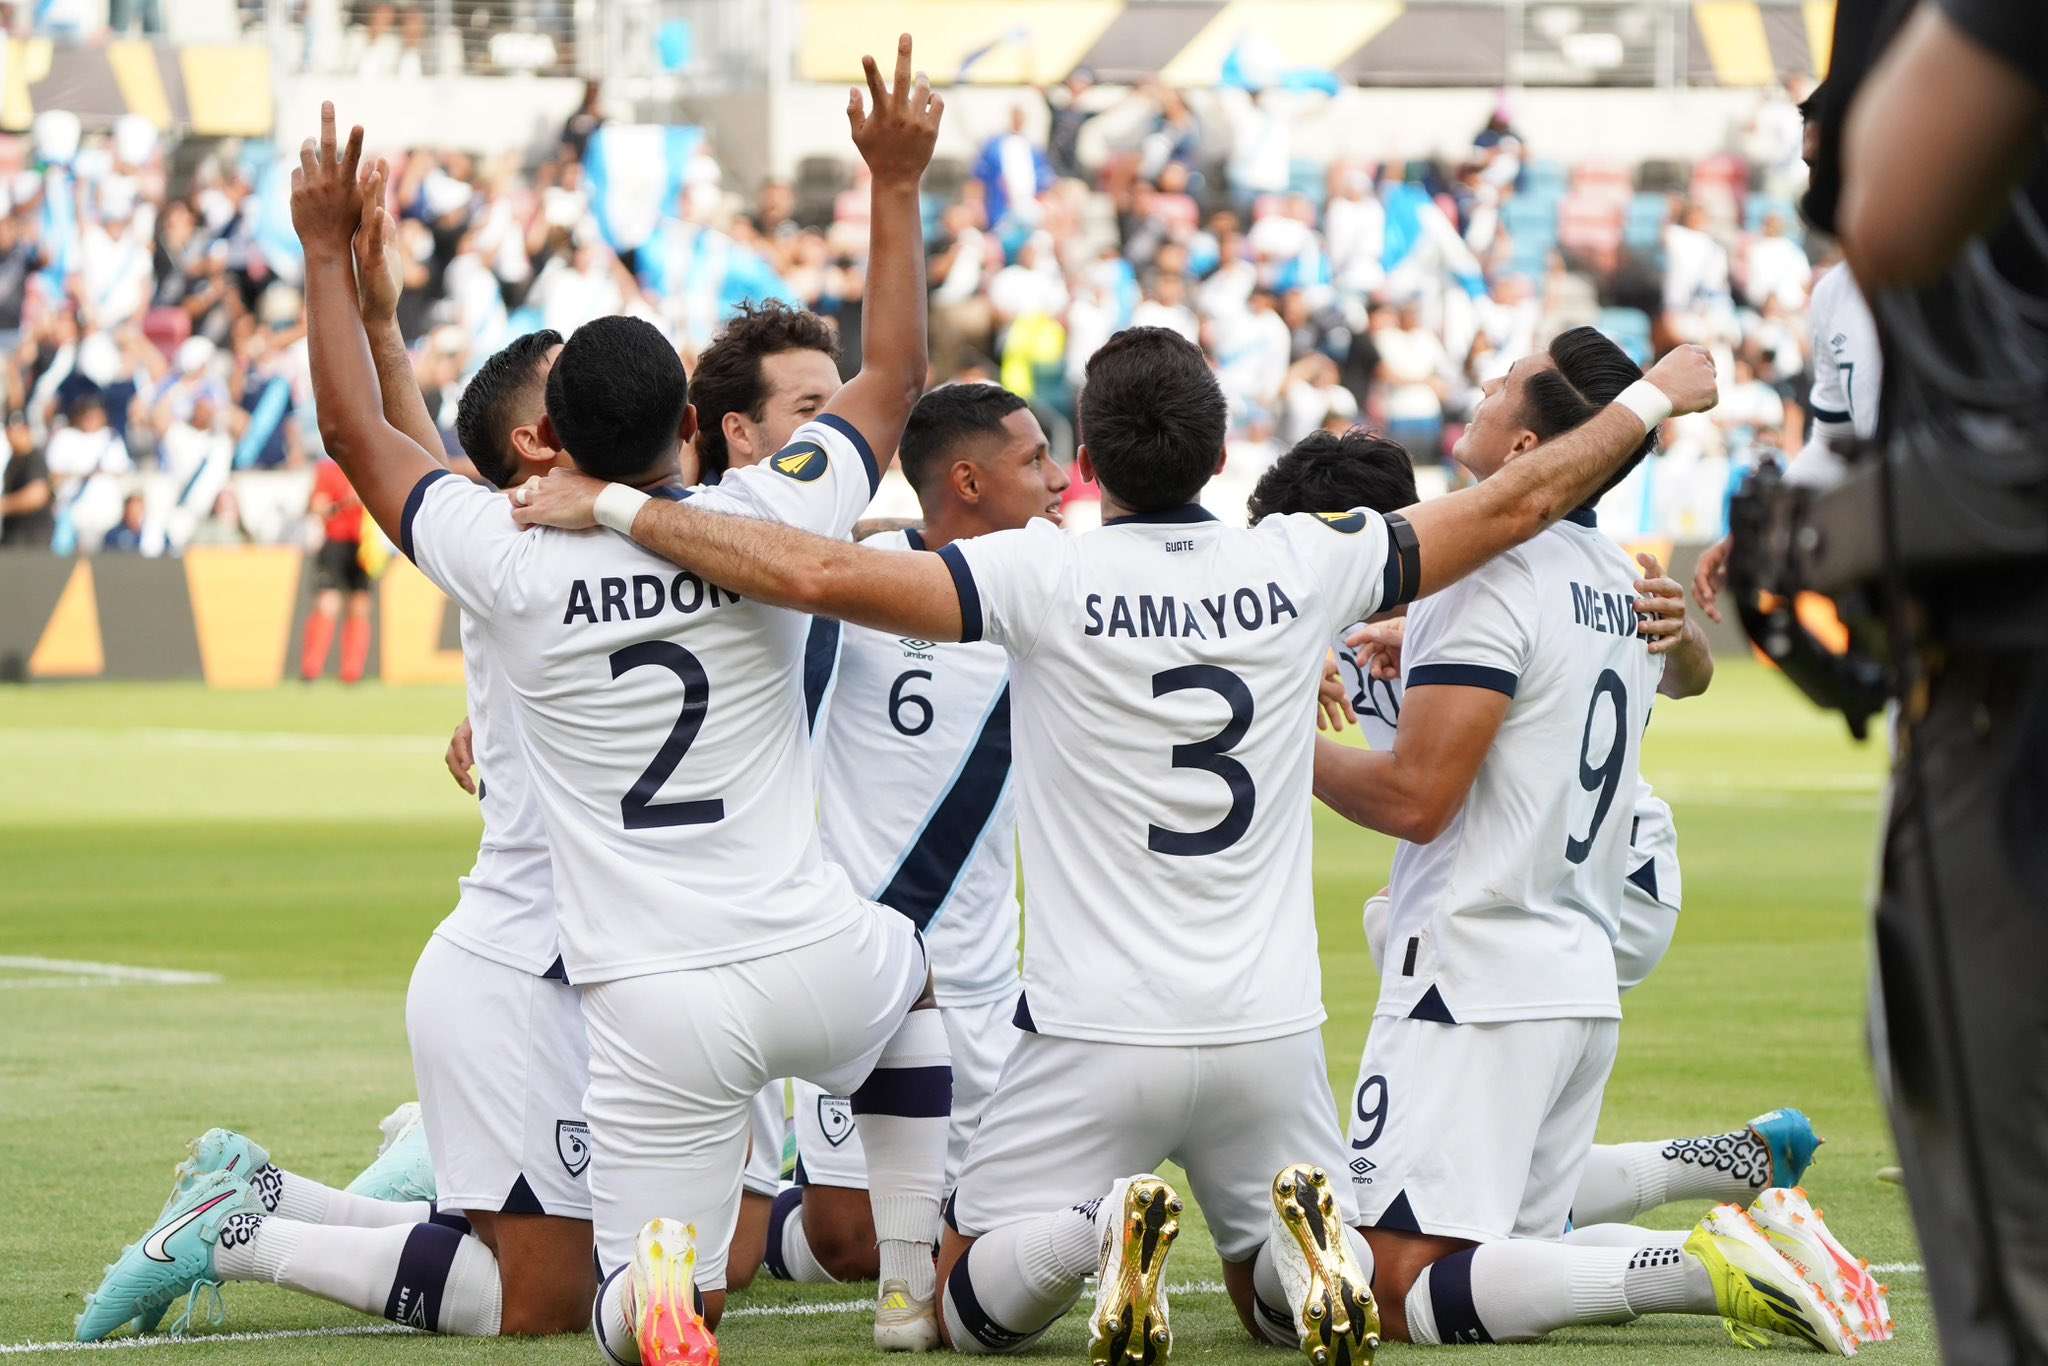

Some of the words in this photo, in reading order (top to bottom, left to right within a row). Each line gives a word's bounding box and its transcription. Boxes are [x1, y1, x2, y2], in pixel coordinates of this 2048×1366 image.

[1166, 540, 1194, 552] GUATE
[1085, 582, 1299, 640] SAMAYOA
[903, 651, 934, 661] umbro
[609, 640, 725, 829] 2
[888, 669, 934, 737] 6
[1147, 664, 1256, 857] 3
[1565, 668, 1627, 864] 9
[1351, 1075, 1389, 1150] 9
